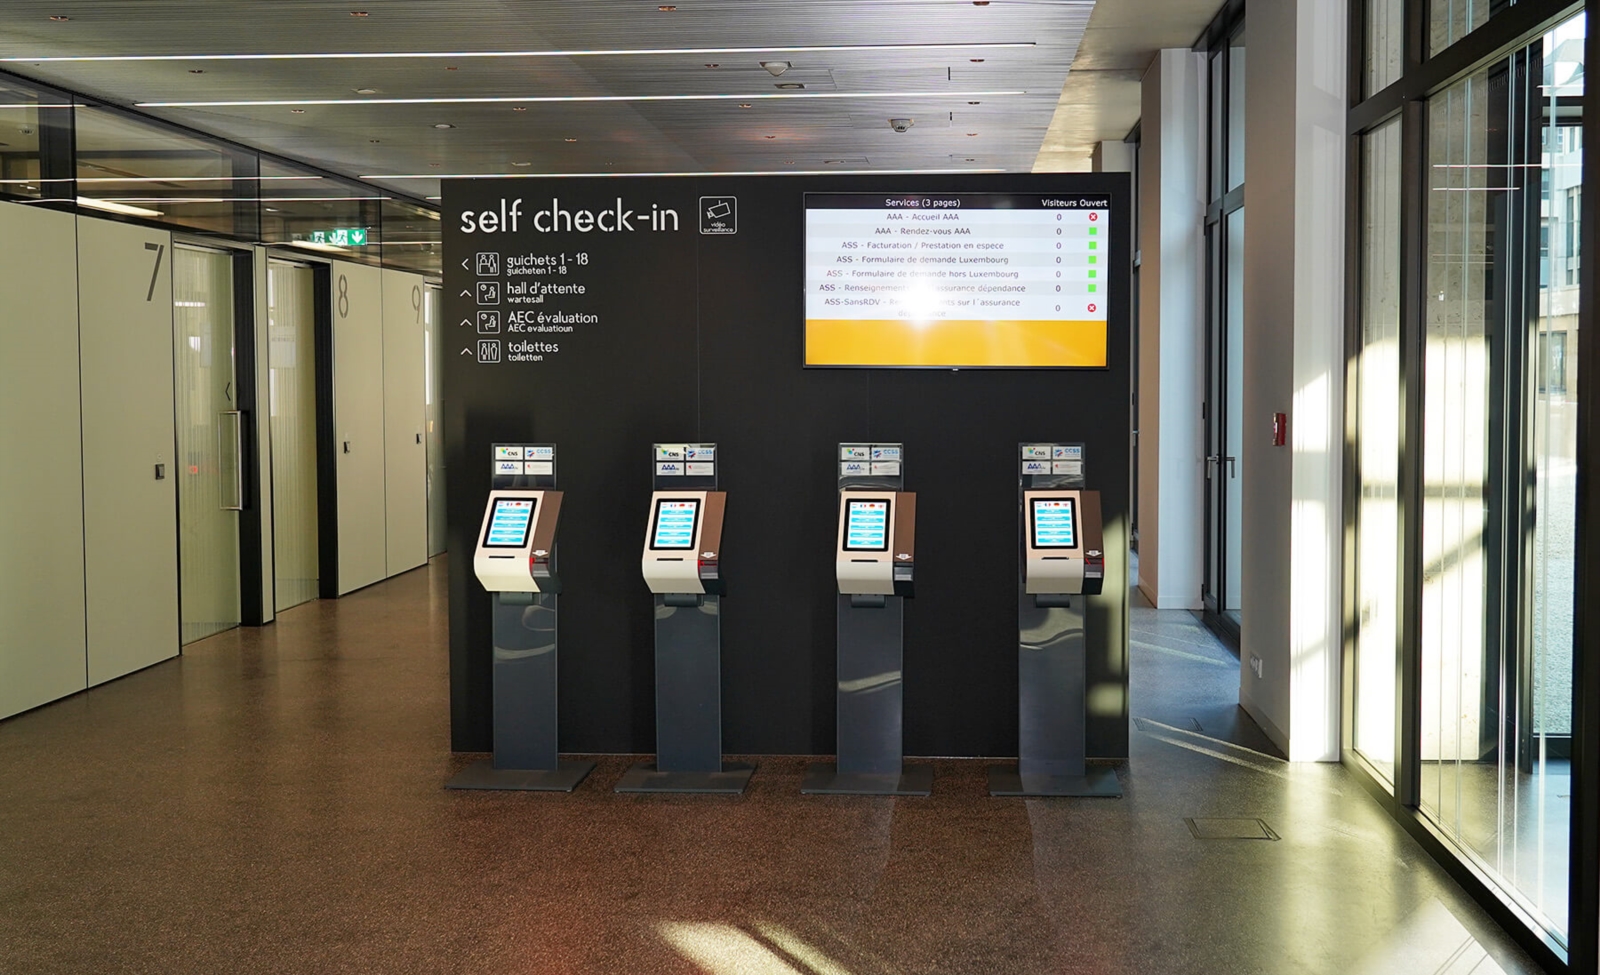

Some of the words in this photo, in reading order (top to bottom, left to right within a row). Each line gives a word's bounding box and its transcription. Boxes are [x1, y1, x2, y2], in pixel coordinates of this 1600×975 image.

[885, 198, 920, 208] Services
[921, 198, 931, 208] (3
[933, 198, 961, 209] pages)
[1041, 199, 1078, 207] Visiteurs
[1079, 199, 1108, 207] Ouvert
[460, 198, 523, 234] self
[533, 197, 679, 233] check-in
[886, 213, 903, 221] AAA
[911, 213, 941, 221] Accueil
[943, 213, 960, 221] AAA
[1056, 213, 1062, 221] 0
[874, 227, 891, 235] AAA
[900, 227, 952, 235] Rendez-vous
[954, 227, 971, 235] AAA
[1056, 228, 1062, 236] 0
[841, 241, 858, 249] ASS
[867, 241, 913, 249] Facturation
[921, 241, 962, 249] Prestation
[976, 243, 1004, 251] espece
[1056, 242, 1062, 250] 0
[506, 252, 557, 267] guichets
[560, 252, 565, 265] 1
[576, 252, 589, 265] 18
[836, 255, 853, 263] ASS
[862, 255, 905, 263] Formulaire
[907, 255, 918, 263] de
[920, 255, 957, 263] demande
[959, 255, 1009, 266] Luxembourg
[1056, 256, 1062, 264] 0
[144, 242, 165, 302] 7
[506, 266, 546, 276] guicheten
[548, 267, 551, 275] 1
[559, 267, 567, 275] 18
[827, 269, 843, 278] ASS
[852, 269, 895, 278] Formulaire
[897, 269, 907, 278] de
[949, 269, 967, 278] hors
[969, 269, 1019, 280] Luxembourg
[1055, 270, 1061, 278] 0
[507, 281, 527, 295] hall
[529, 281, 586, 295] d'attente
[819, 283, 836, 292] ASS
[978, 282, 1027, 294] dépendance
[1055, 284, 1061, 292] 0
[338, 273, 349, 319] 8
[507, 294, 544, 304] wartesall
[411, 284, 421, 325] 9
[825, 297, 881, 306] ASS-SansRDV
[507, 310, 535, 323] AEC
[537, 310, 598, 324] évaluation
[507, 323, 526, 333] AEC
[527, 323, 573, 333] evaluatioun
[507, 341, 559, 353] toilettes
[507, 352, 543, 362] toiletten
